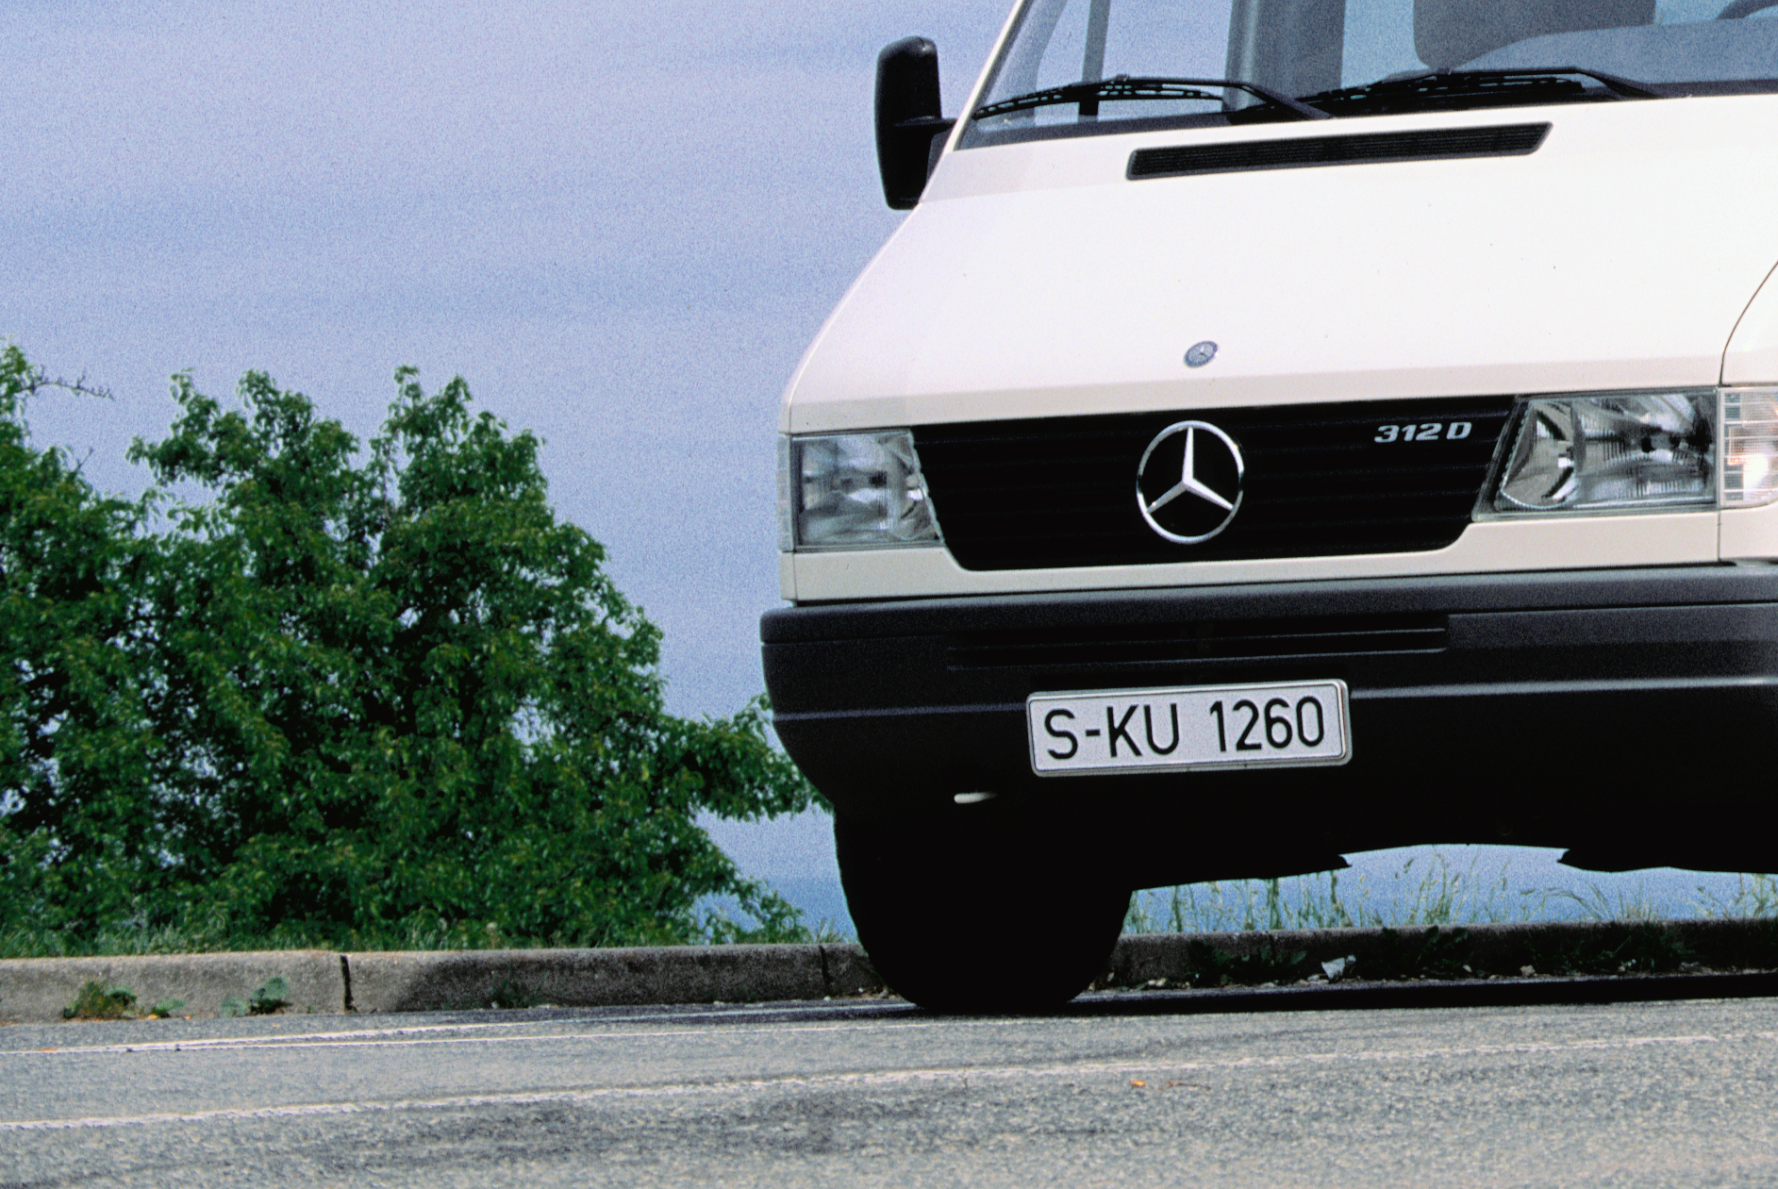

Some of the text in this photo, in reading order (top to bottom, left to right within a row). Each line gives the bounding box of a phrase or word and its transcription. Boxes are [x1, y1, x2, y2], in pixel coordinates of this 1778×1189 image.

[1374, 422, 1443, 443] 312
[1044, 696, 1325, 760] S-KU 1260
